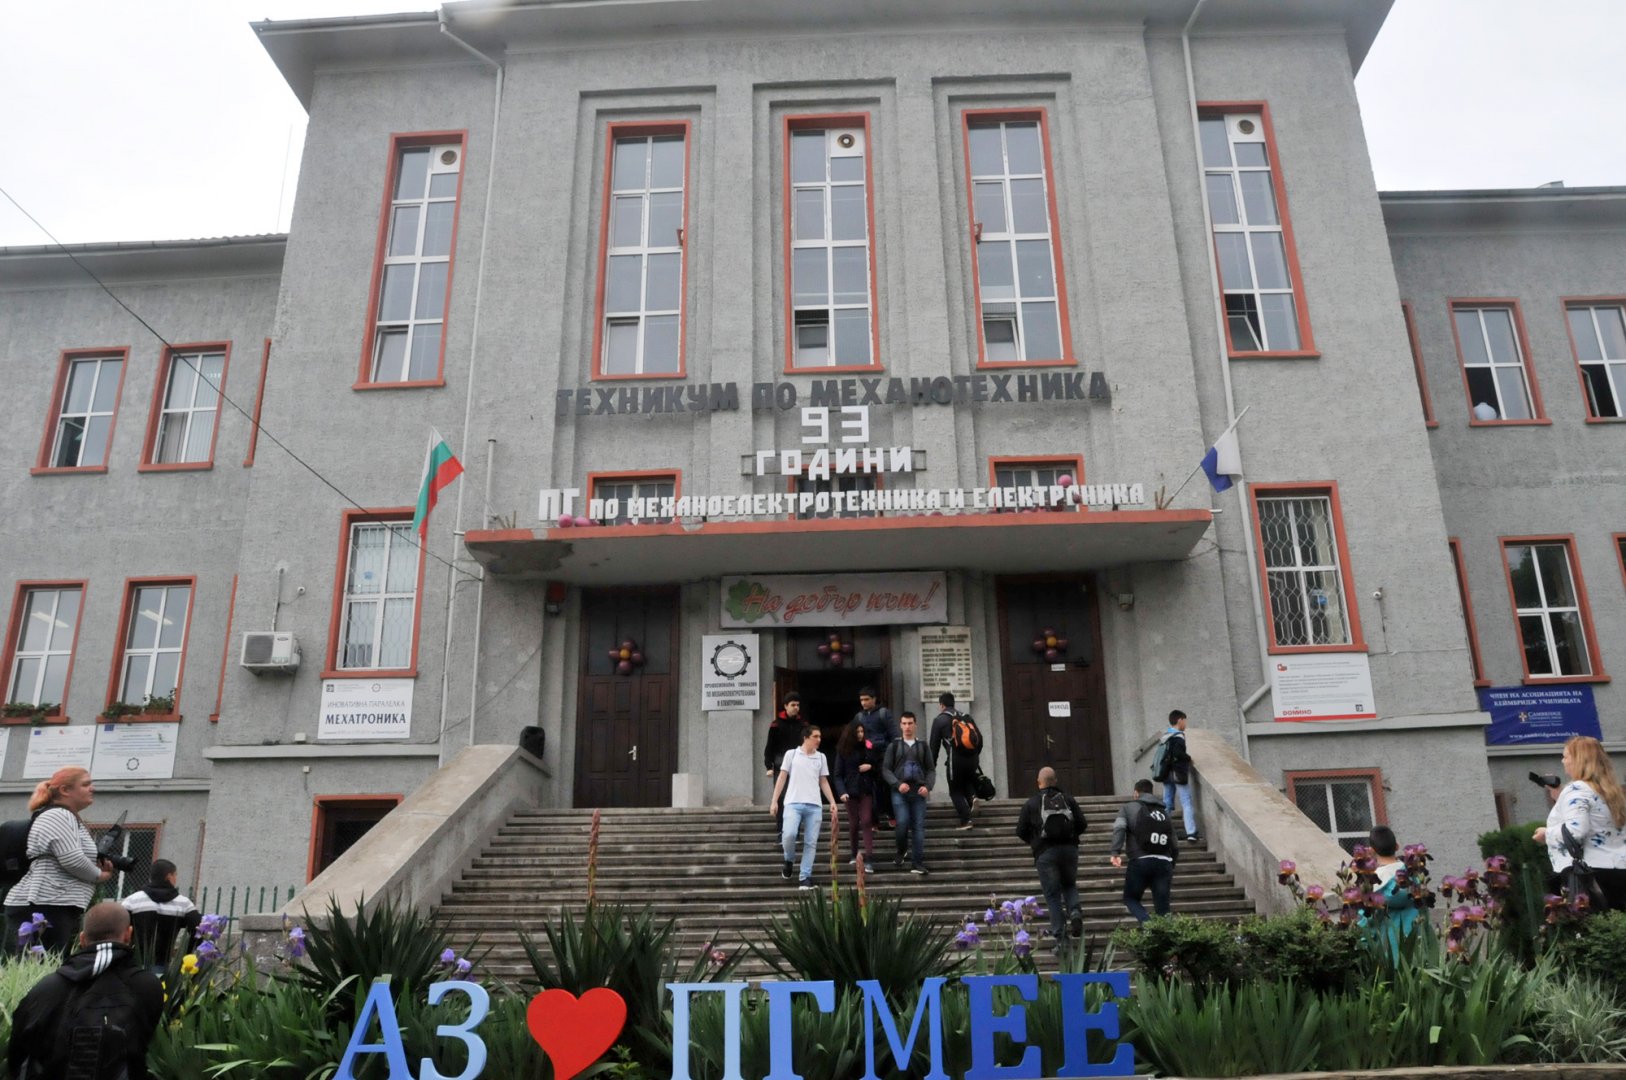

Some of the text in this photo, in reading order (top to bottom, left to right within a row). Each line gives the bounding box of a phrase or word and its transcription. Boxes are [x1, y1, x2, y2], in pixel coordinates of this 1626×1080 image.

[556, 371, 1112, 416] ТЕХНИКУМ ПО МЕХАНОТЕХНИКА
[801, 405, 869, 444] 93
[756, 446, 912, 481] ГОДИНИ
[538, 482, 1144, 521] ПГ ПО МЕХАНОЕЛЕКТРОТЕХНИКА И ЕЛЕКТРОНИКА
[744, 583, 783, 613] На
[325, 713, 406, 725] МЕХАТРОНИКА
[331, 972, 1135, 1080] АЗ ПГМЕЕ
